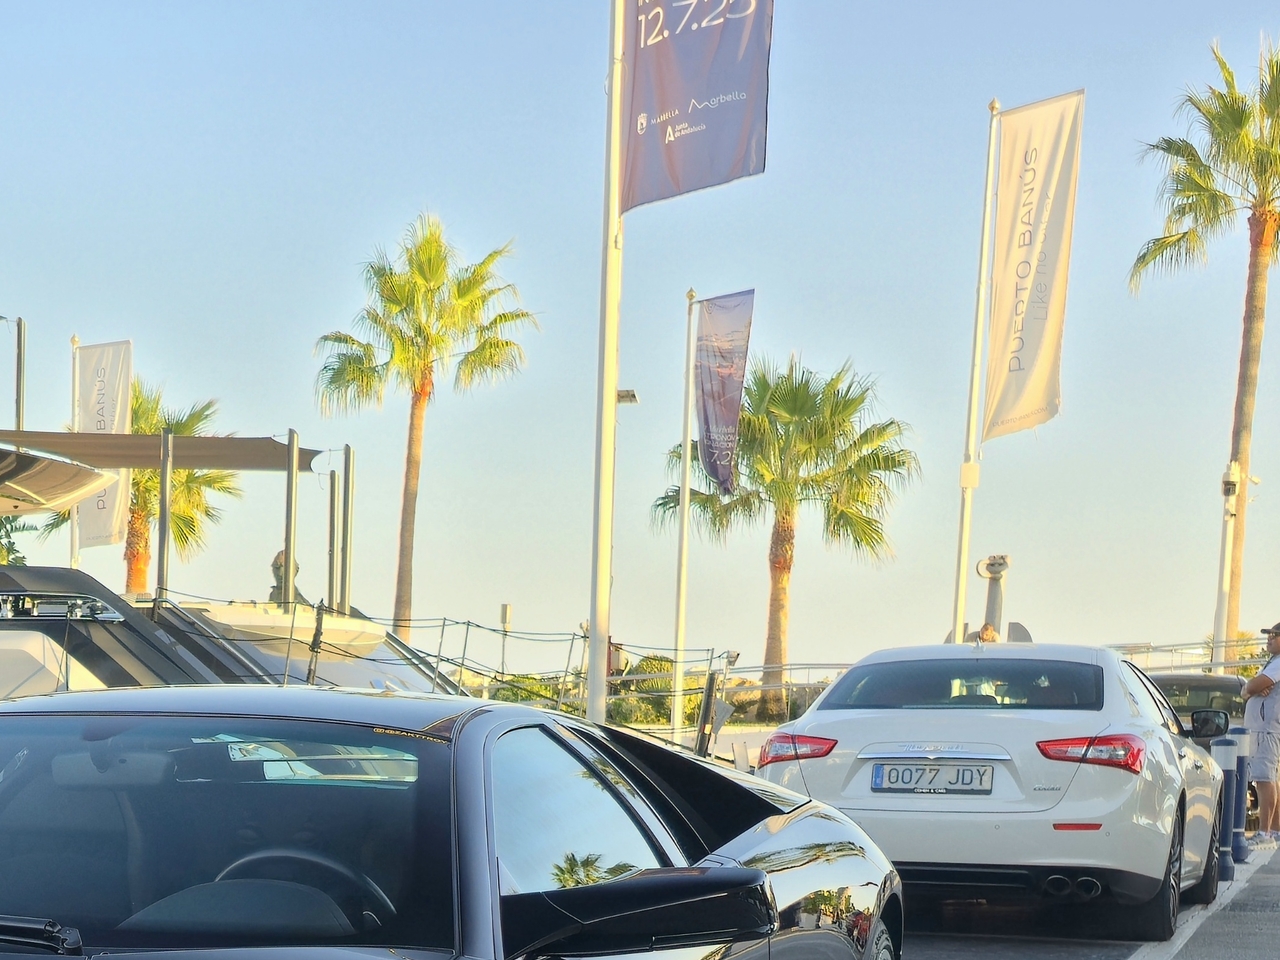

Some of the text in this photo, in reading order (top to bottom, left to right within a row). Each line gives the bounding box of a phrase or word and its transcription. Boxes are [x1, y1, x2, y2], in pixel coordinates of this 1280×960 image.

[688, 91, 747, 113] Marbella
[1009, 147, 1038, 373] PUERTO BANÚS
[888, 768, 988, 786] 0077 JDY
